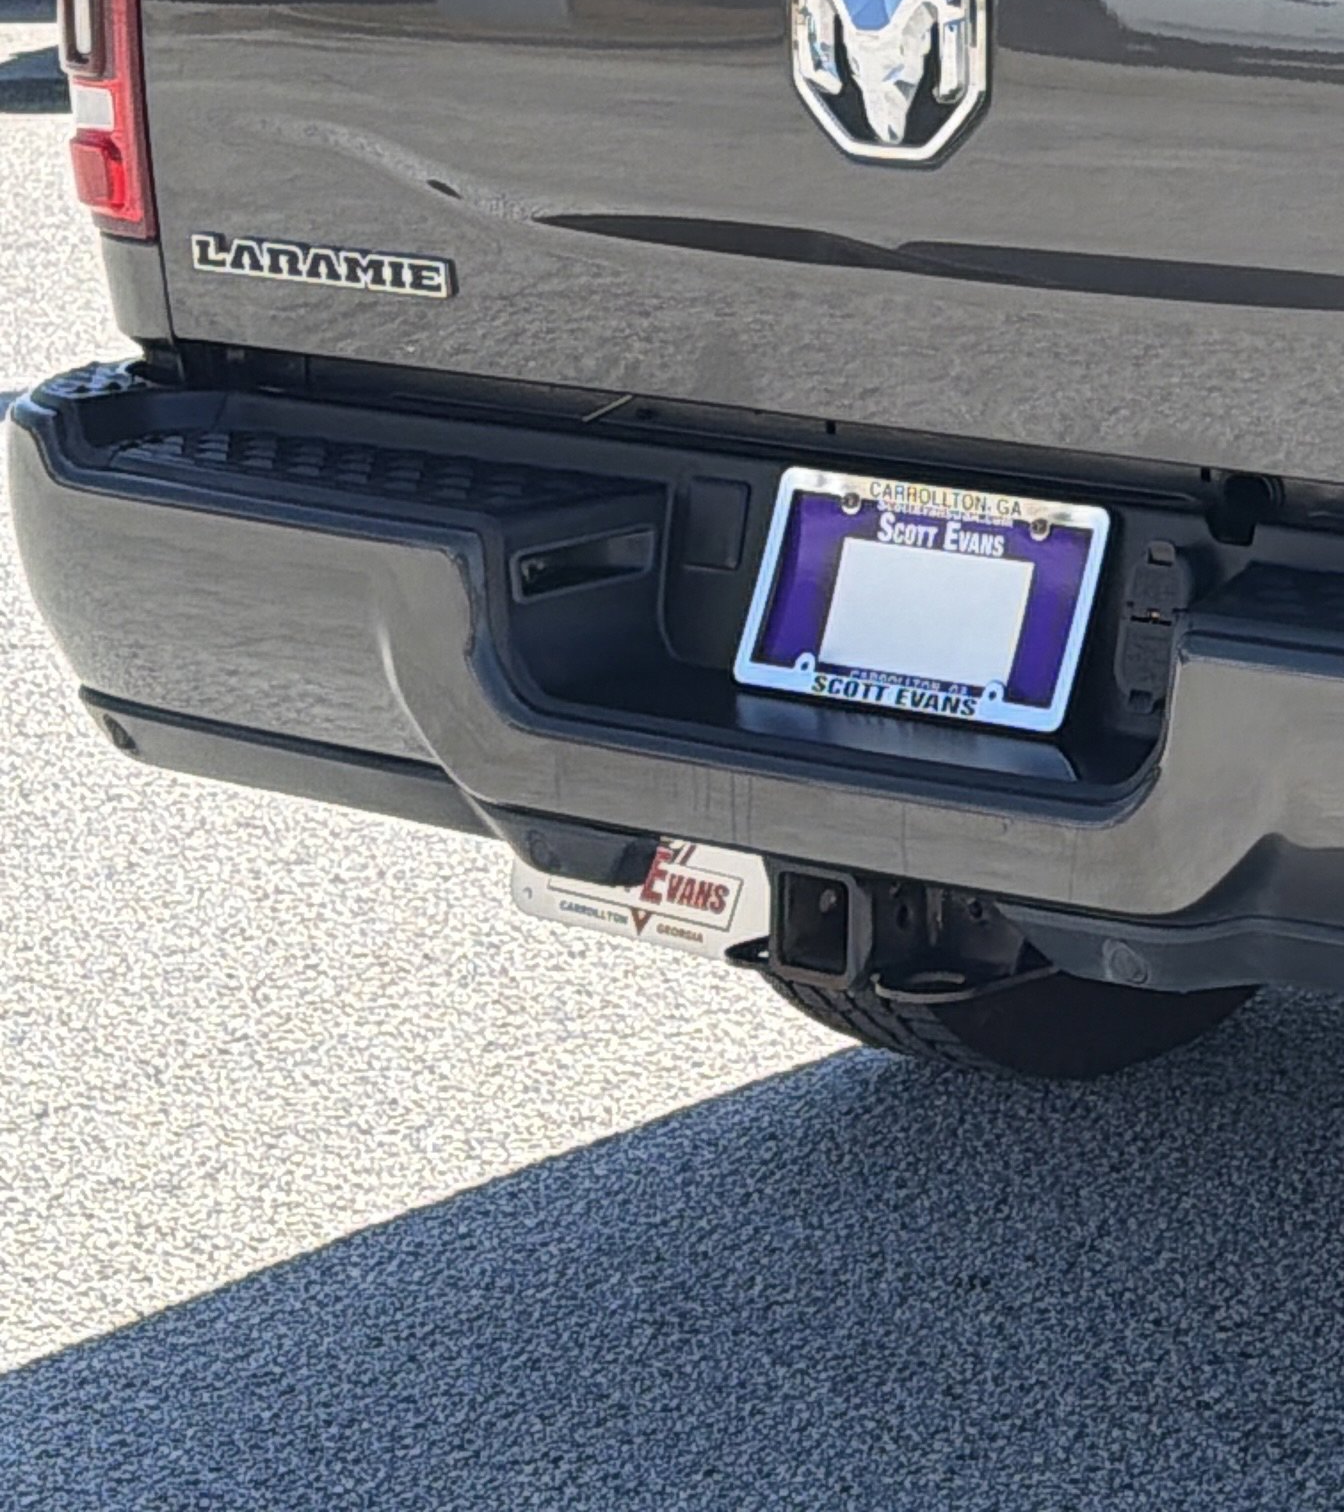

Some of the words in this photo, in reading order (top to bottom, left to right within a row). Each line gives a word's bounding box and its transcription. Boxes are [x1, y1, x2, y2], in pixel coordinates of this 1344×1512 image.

[191, 234, 449, 298] LARAMIE
[997, 499, 1022, 516] GA
[877, 512, 939, 548] SCOTT
[943, 521, 1005, 556] EVANS
[812, 675, 890, 701] SCOTT
[895, 687, 977, 716] EVANS
[639, 845, 731, 915] EVANS
[559, 900, 629, 925] CARROLLTON
[656, 923, 703, 943] GEORGIA
